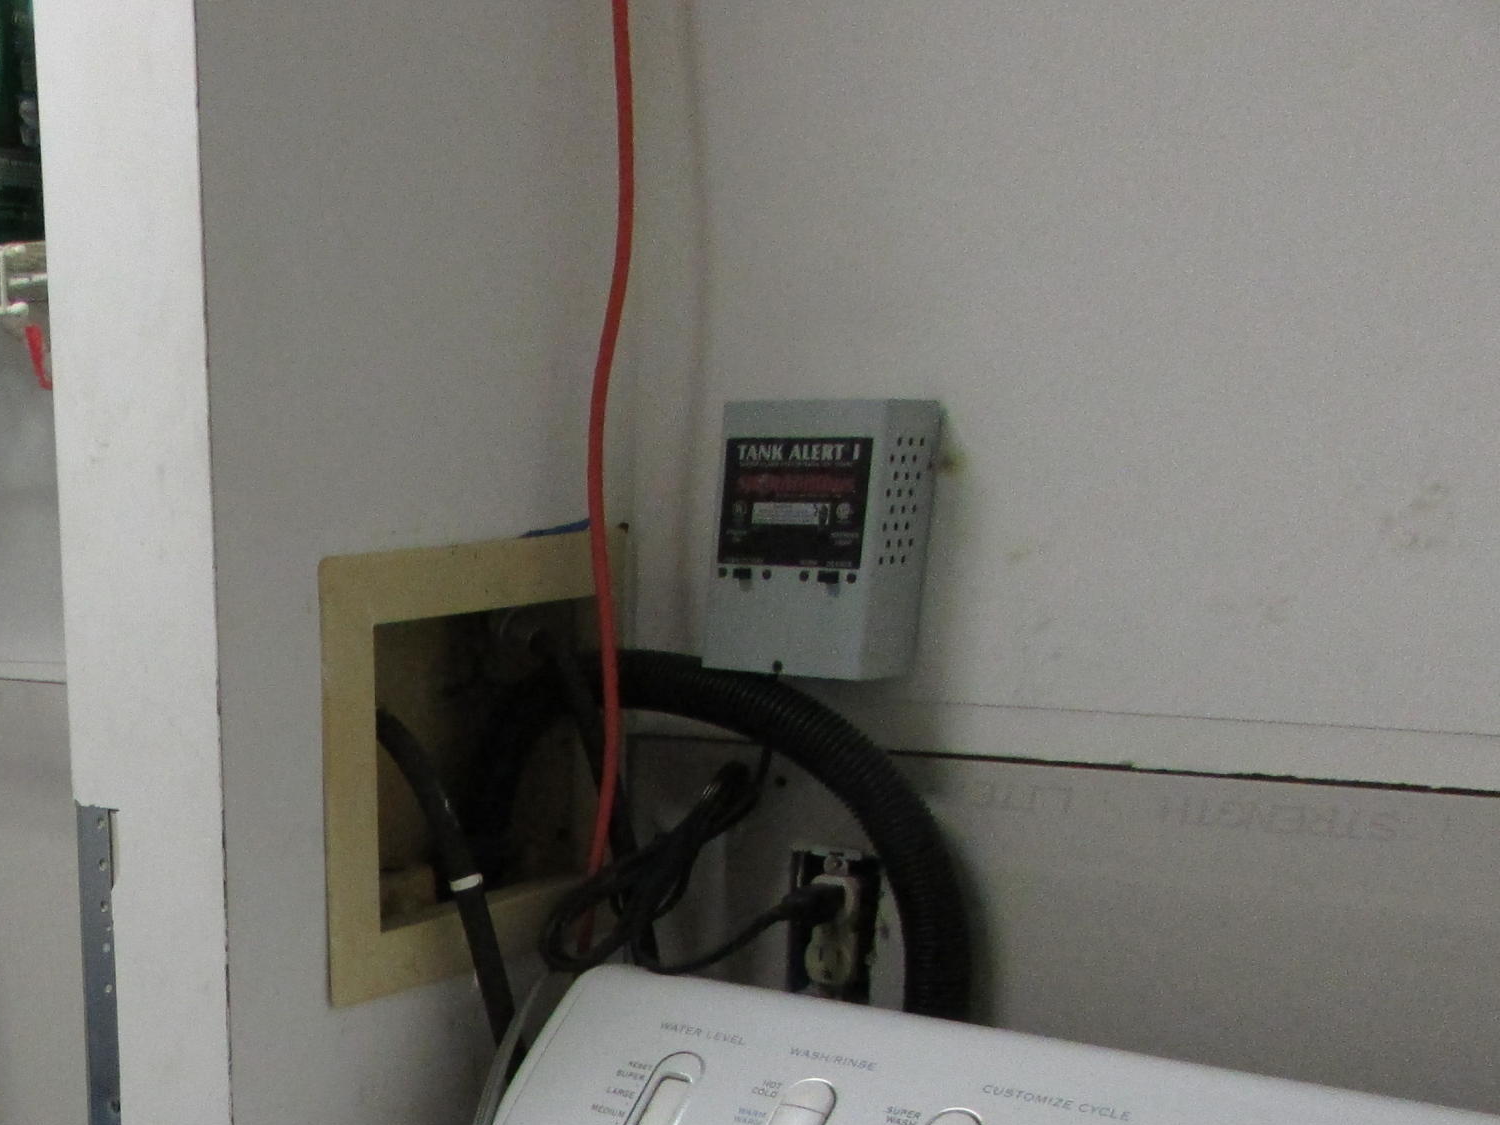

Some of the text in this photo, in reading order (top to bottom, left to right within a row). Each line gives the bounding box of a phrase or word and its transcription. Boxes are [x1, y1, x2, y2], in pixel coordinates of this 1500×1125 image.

[737, 444, 784, 461] TANK
[789, 443, 844, 461] ALERT
[660, 1021, 746, 1046] WATER LEVEL
[789, 1047, 878, 1072] WASH/RINSE
[615, 1069, 646, 1081] SUPER
[605, 1086, 636, 1100] LARGE
[751, 1087, 778, 1099] COLD
[591, 1103, 626, 1118] MEDIUM
[982, 1084, 1133, 1122] CUSTOMIZE CYCLE
[885, 1105, 922, 1120] SUPER
